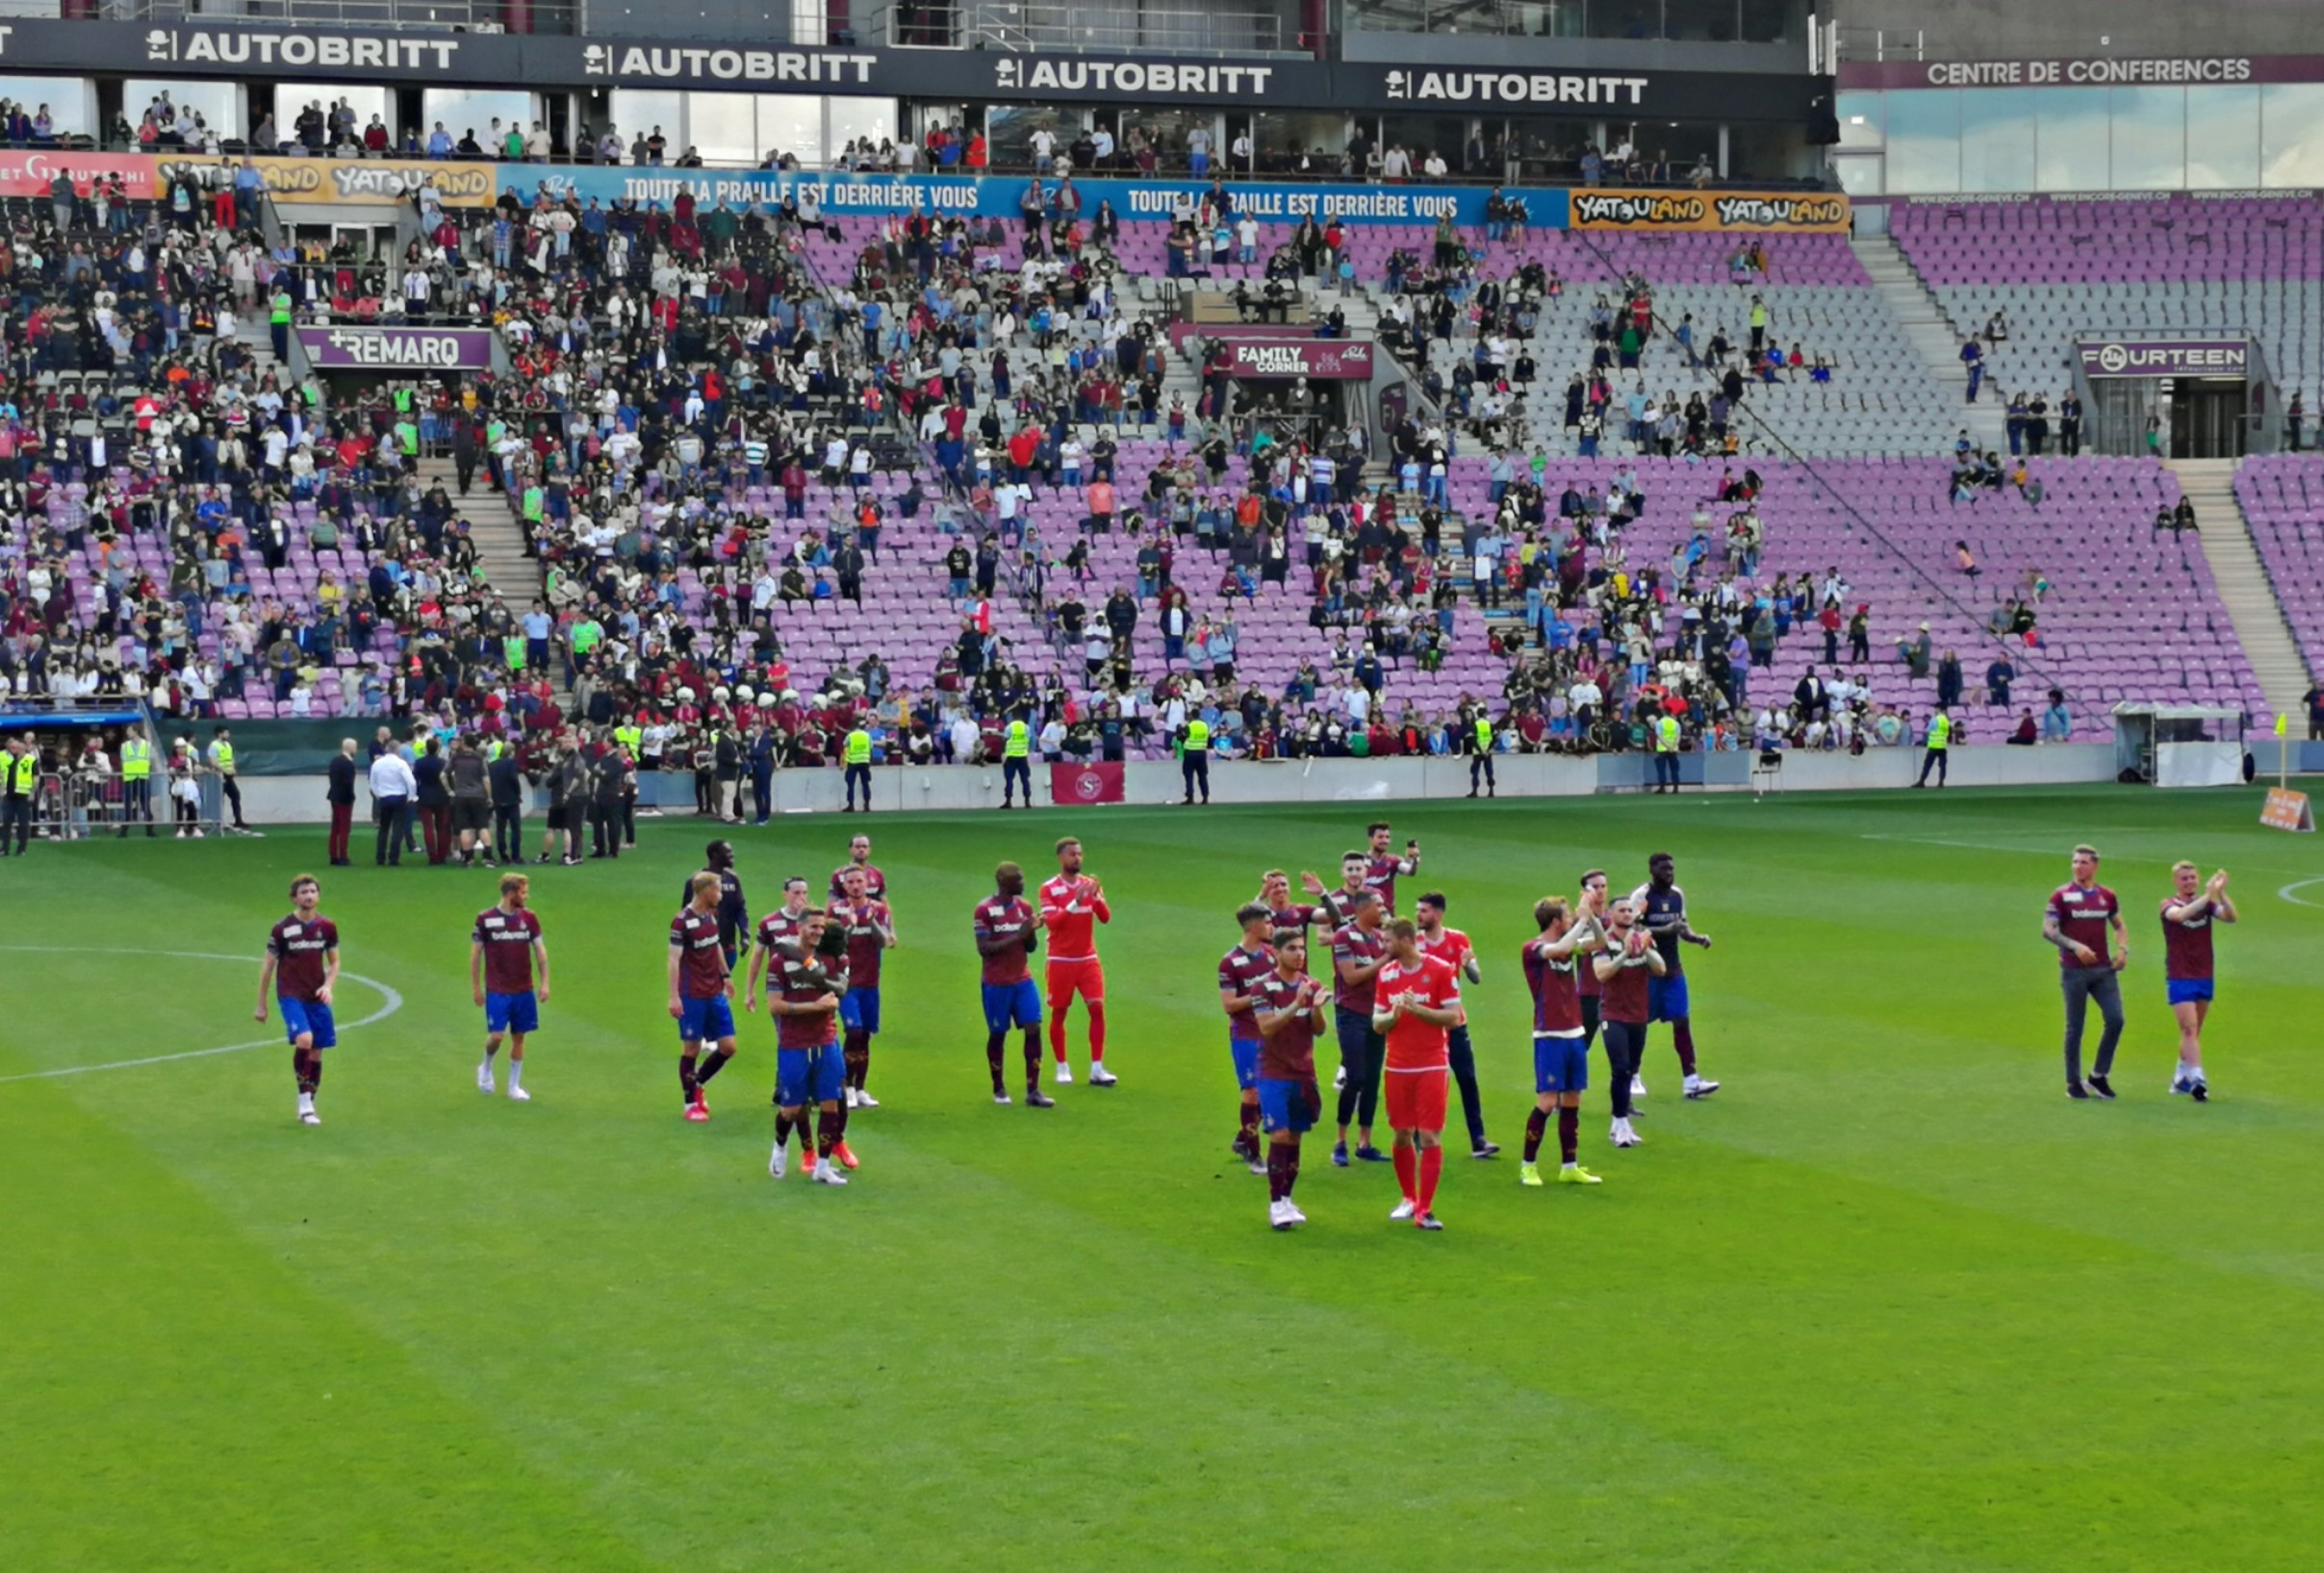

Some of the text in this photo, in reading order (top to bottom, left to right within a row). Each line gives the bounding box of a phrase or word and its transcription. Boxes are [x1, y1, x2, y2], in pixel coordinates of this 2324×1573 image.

[185, 32, 458, 68] AUTOBRITT
[620, 47, 877, 83] AUTOBRITT
[1030, 61, 1272, 94] AUTOBRITT
[1928, 59, 2250, 85] CENTRE DE CONFERENCES
[1418, 72, 1648, 104] AUTOBRITT
[335, 165, 487, 195] YATOUAND
[625, 178, 683, 201] TOUTE
[797, 183, 829, 205] EST
[834, 181, 926, 207] DERRIÈRE
[931, 187, 978, 208] VOUS
[1227, 192, 1283, 215] RAILLE
[1288, 194, 1318, 215] EST
[1323, 191, 1409, 216] DERRIÈRE
[1413, 195, 1458, 217] VOUS
[345, 335, 460, 367] REMARQ
[1238, 346, 1302, 363] FAMILY
[1256, 361, 1309, 373] CORNER
